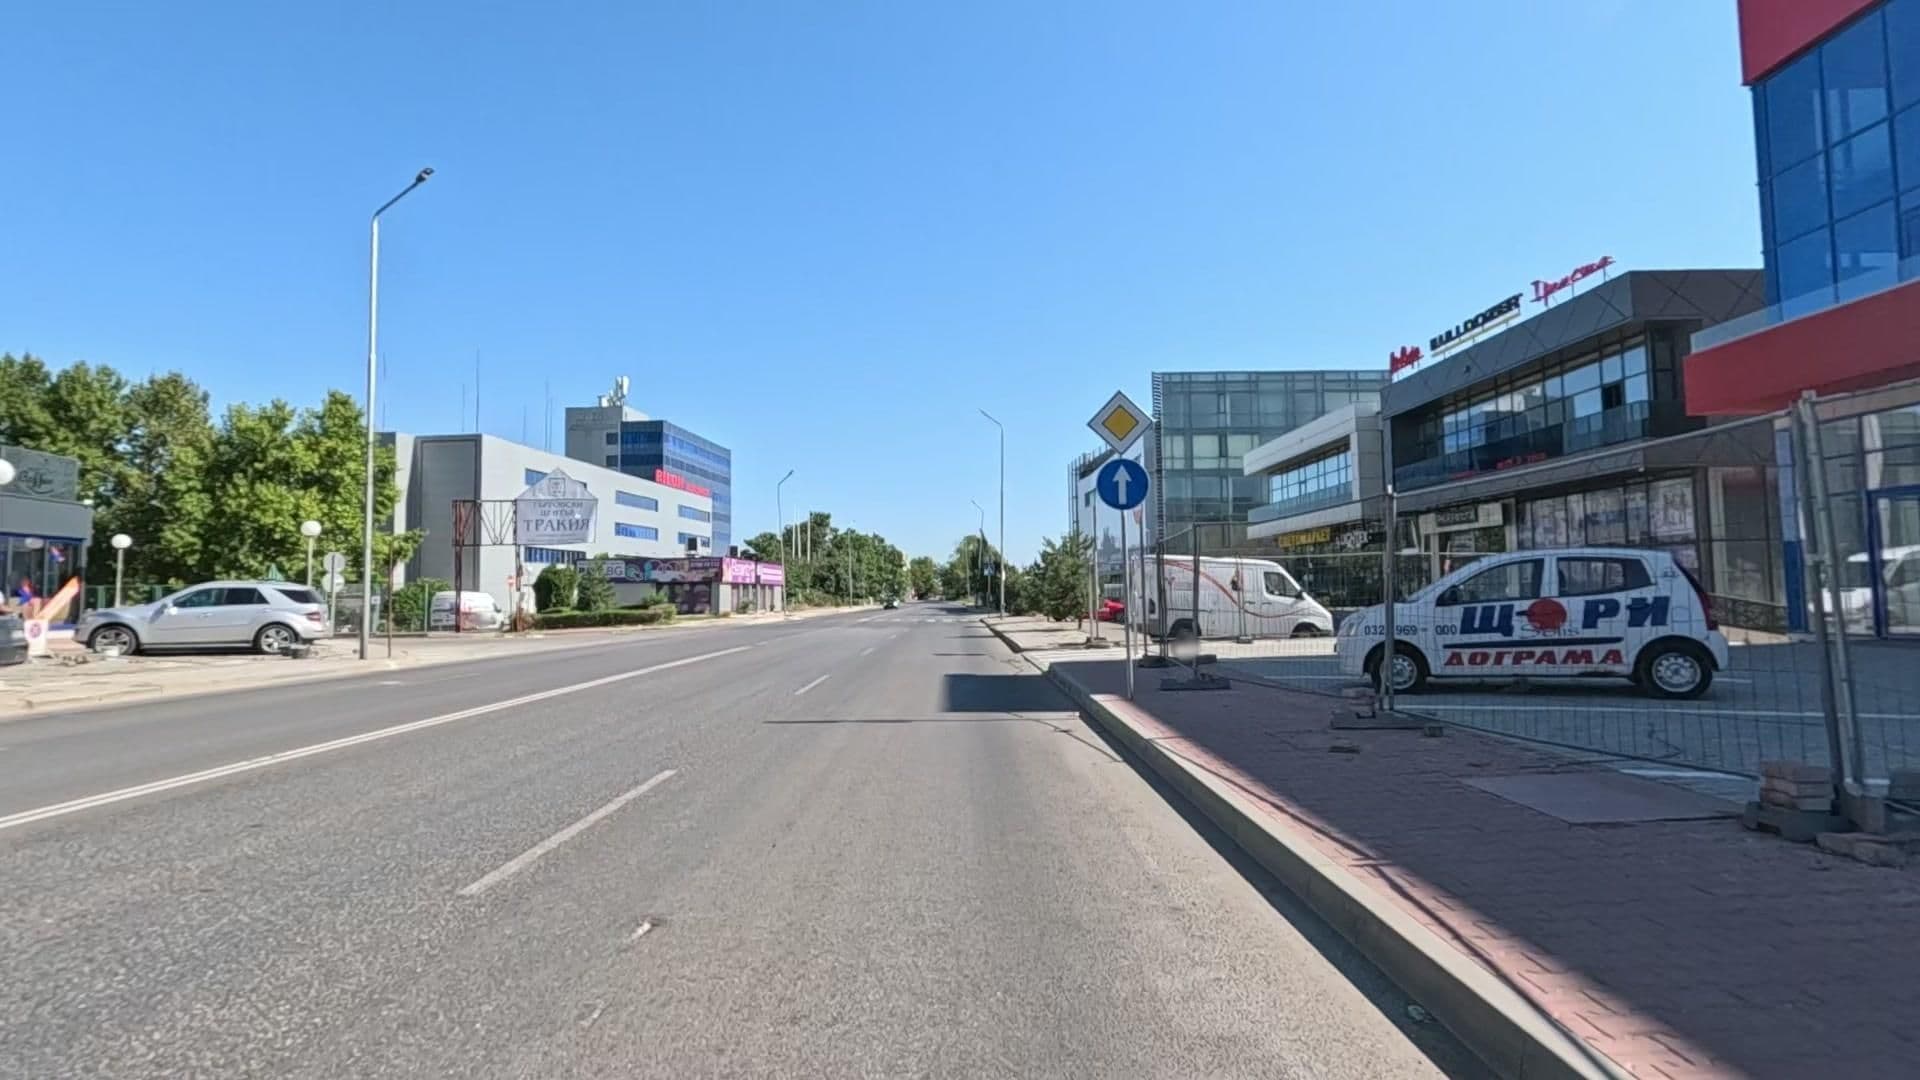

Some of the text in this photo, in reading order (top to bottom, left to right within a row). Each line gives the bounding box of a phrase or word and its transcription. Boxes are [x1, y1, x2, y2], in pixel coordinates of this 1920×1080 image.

[1430, 292, 1524, 351] BULLDOZER
[523, 518, 590, 532] ТРАКИЯ
[1364, 624, 1385, 636] 032
[1395, 624, 1417, 636] 969
[1435, 624, 1458, 636] 000
[1444, 650, 1625, 667] ДОГРАМА
